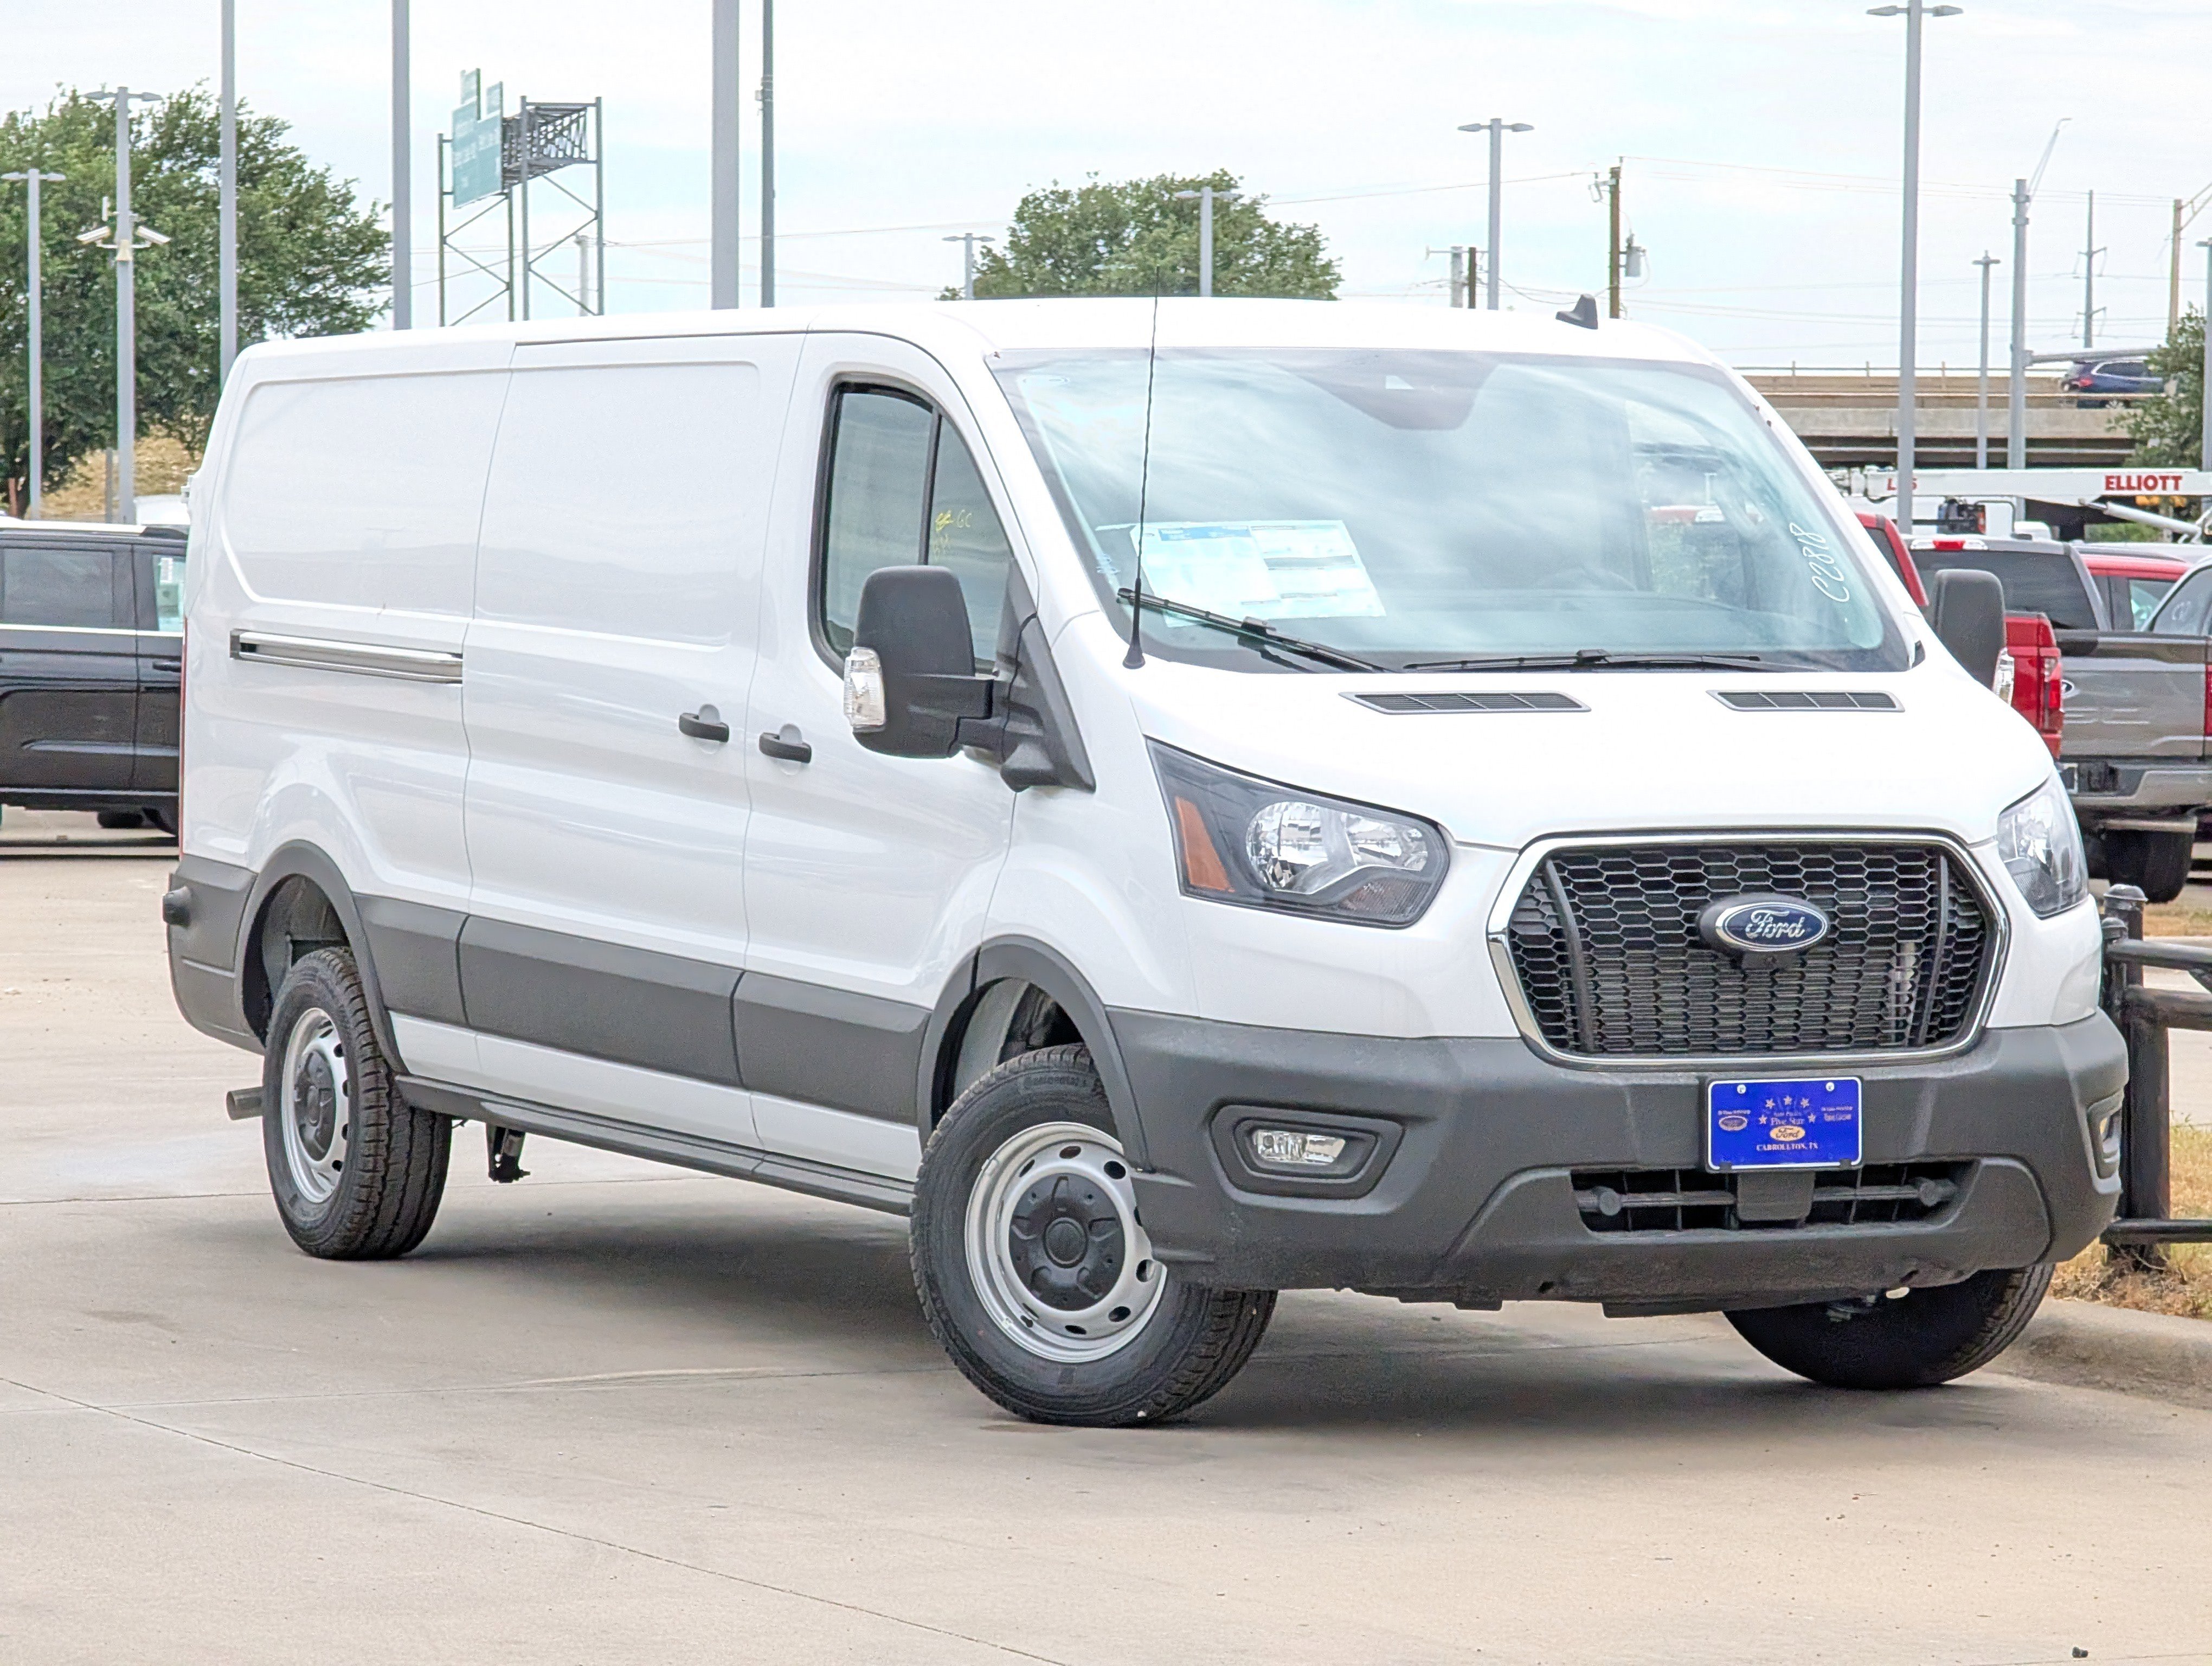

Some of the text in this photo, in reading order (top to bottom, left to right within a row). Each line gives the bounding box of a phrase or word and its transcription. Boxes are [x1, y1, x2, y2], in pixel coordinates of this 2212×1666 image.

[2105, 475, 2183, 491] ELLIOTT
[1745, 909, 1805, 939] Ford
[1776, 1127, 1801, 1138] Ford
